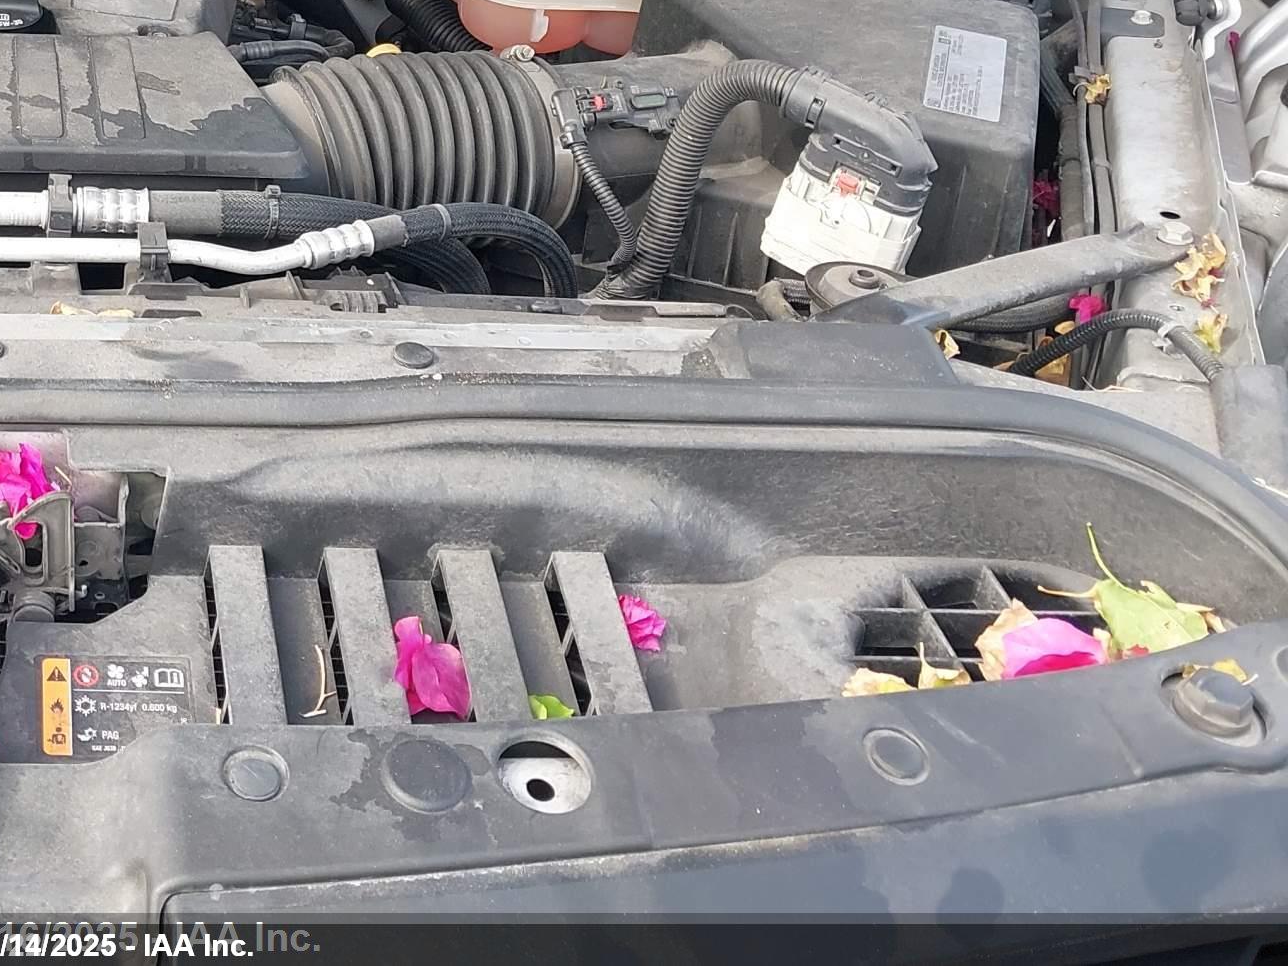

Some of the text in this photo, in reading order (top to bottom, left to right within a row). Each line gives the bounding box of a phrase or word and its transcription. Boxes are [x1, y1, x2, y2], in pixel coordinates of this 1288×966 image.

[106, 679, 127, 687] AUTO
[100, 702, 137, 712] R-1234yf
[166, 702, 178, 714] kg
[101, 730, 120, 740] PAG
